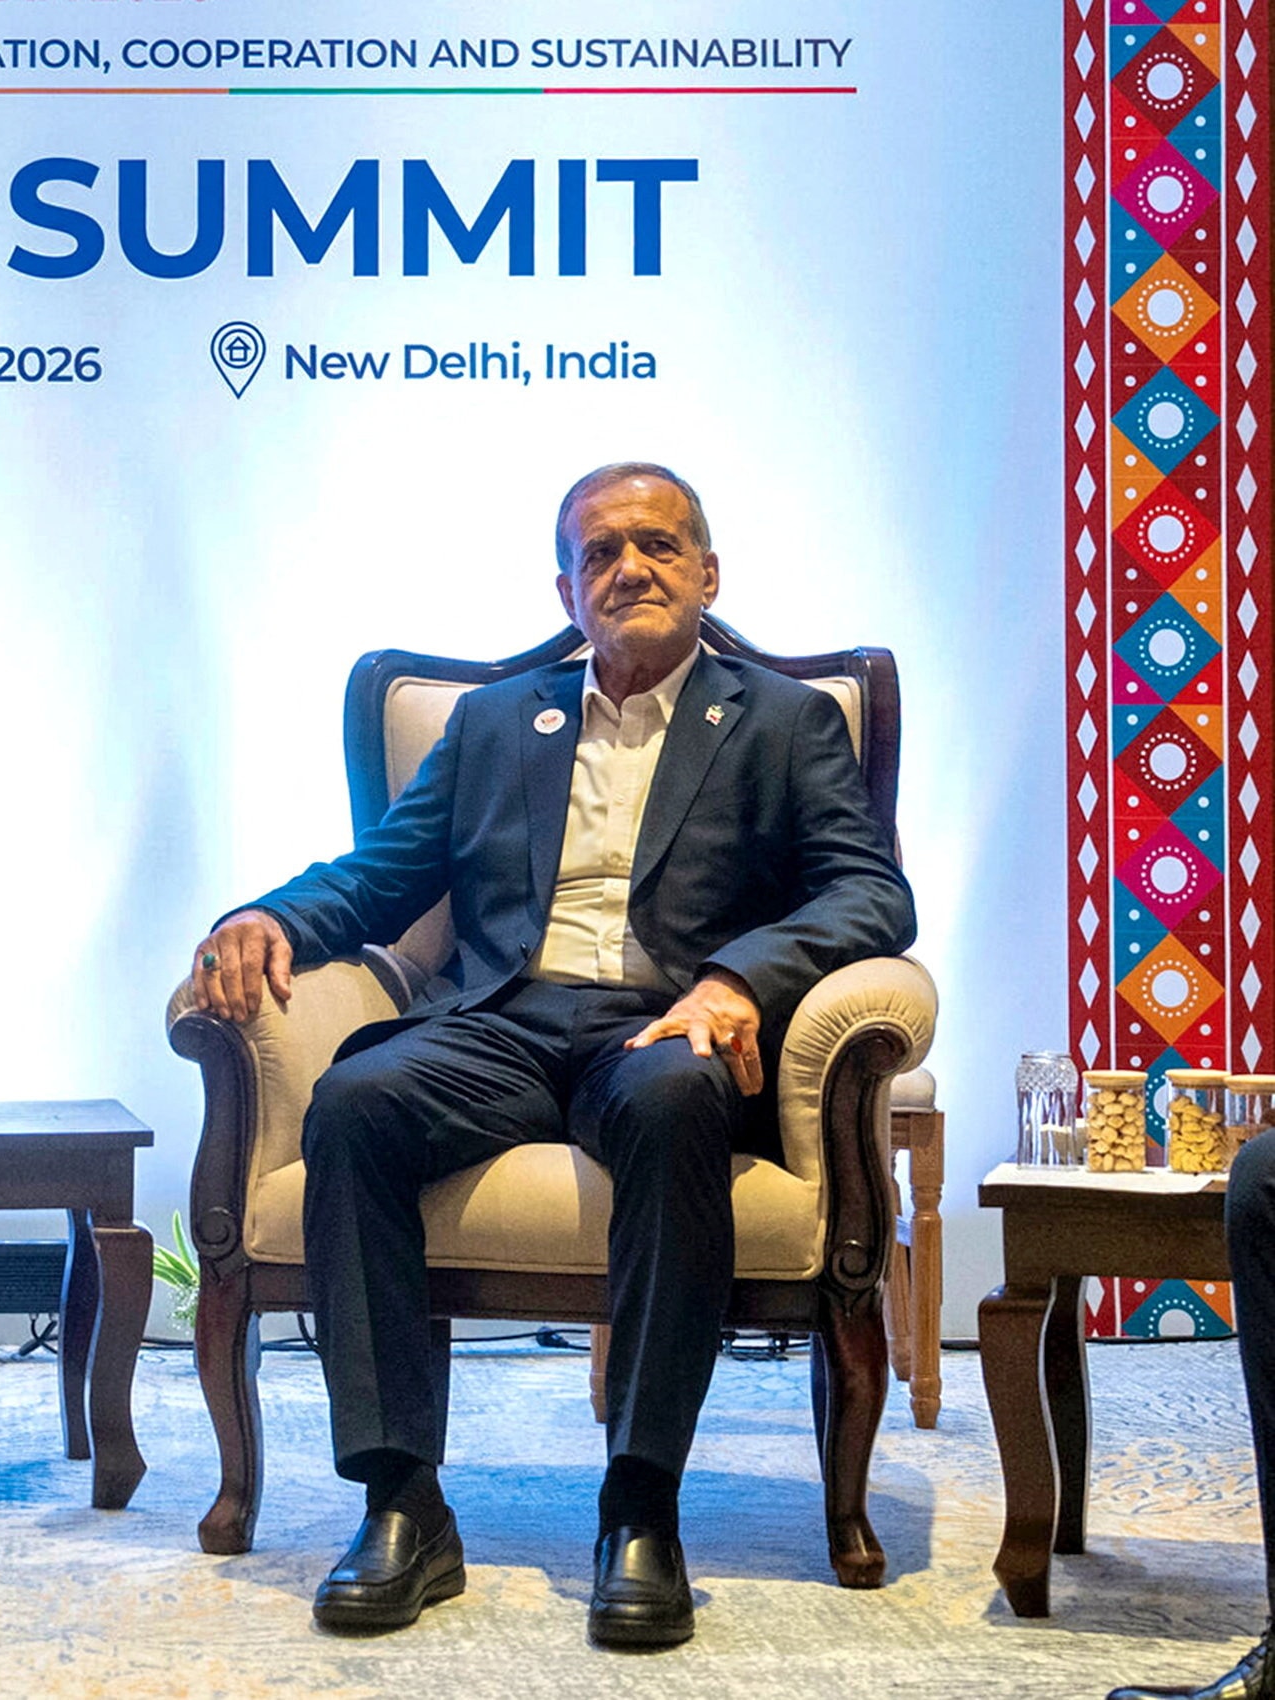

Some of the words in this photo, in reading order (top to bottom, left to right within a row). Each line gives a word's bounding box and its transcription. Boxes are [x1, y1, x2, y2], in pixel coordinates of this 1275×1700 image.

[123, 38, 417, 69] COOPERATION
[428, 39, 519, 68] AND
[531, 38, 853, 68] SUSTAINABILITY
[7, 157, 699, 279] SUMMIT
[285, 344, 390, 380] New
[404, 341, 531, 386] Delhi,
[546, 341, 656, 379] India
